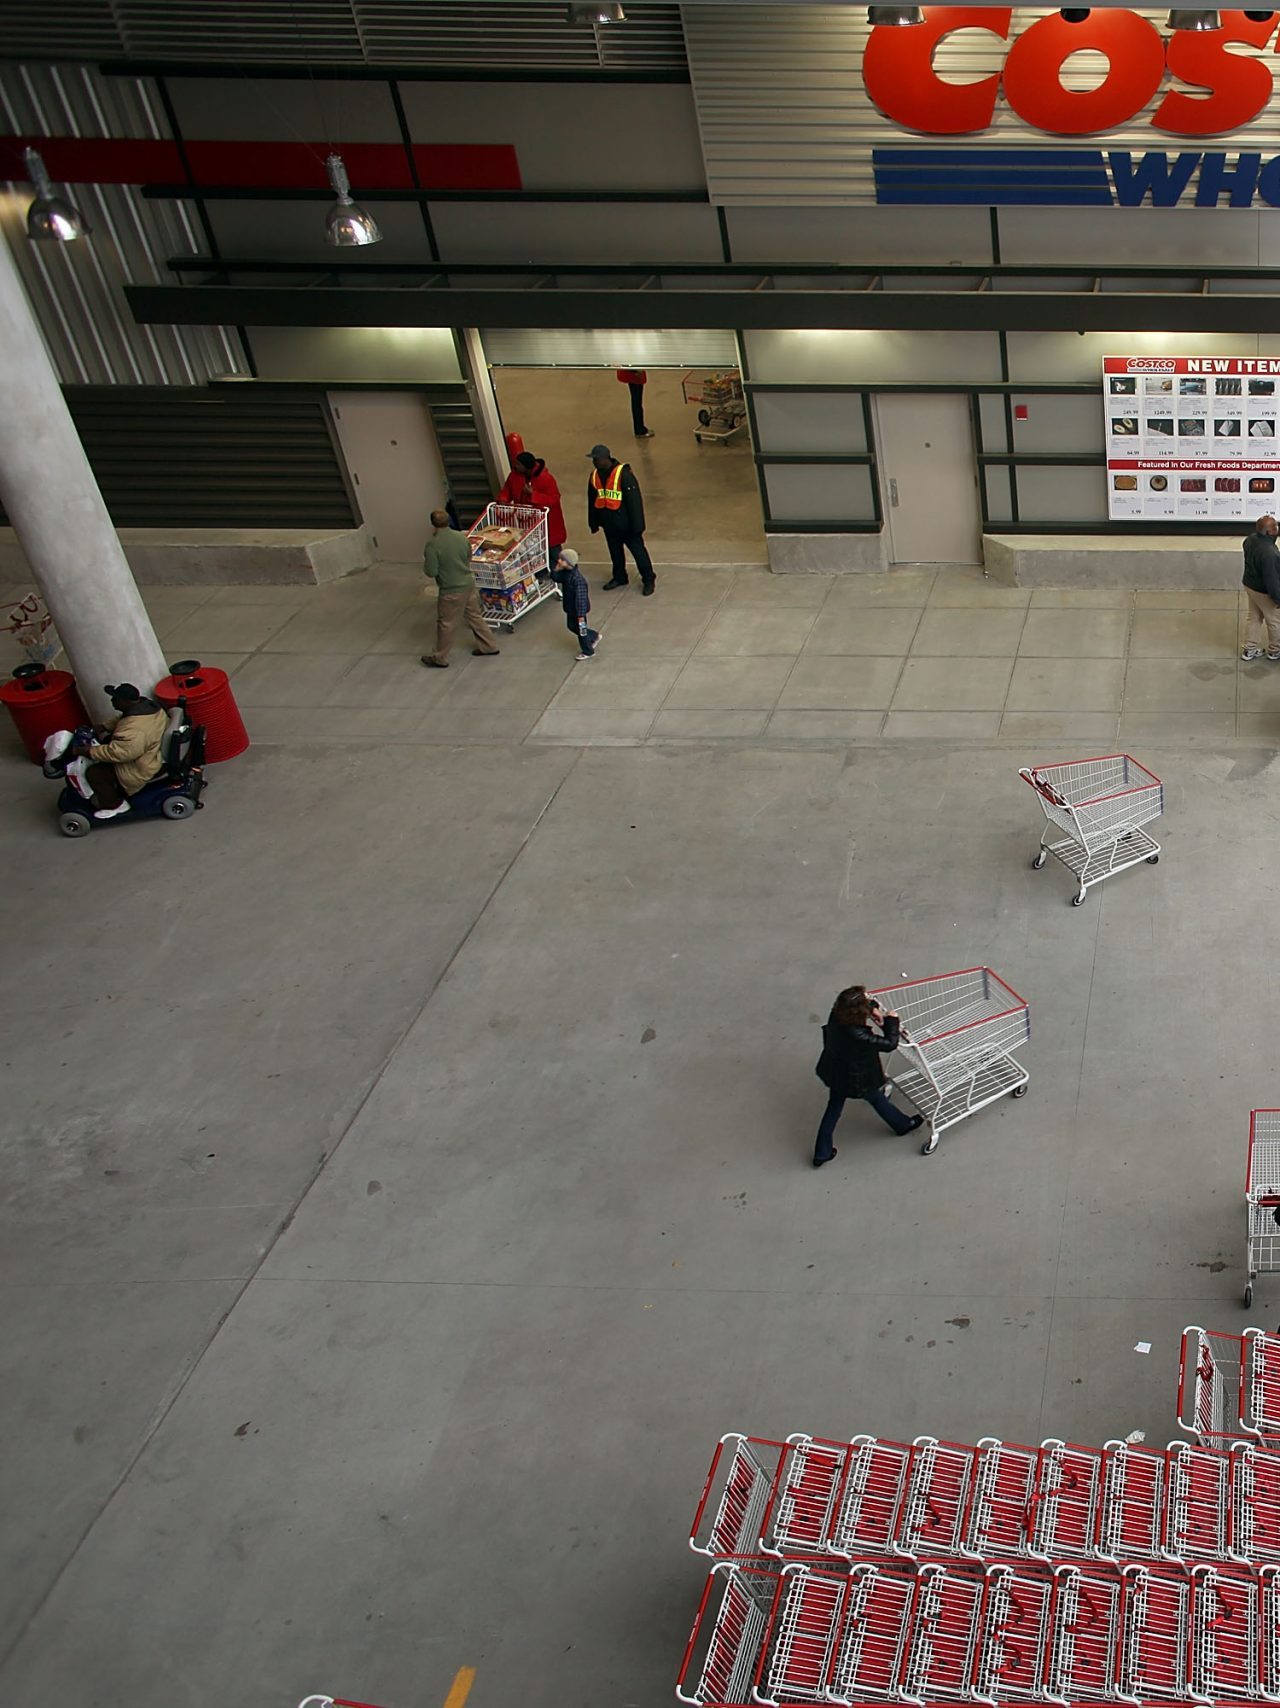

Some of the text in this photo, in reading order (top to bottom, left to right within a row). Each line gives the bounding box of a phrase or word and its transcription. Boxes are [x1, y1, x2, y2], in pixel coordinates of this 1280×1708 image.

[1127, 359, 1175, 368] COSTCO
[1187, 360, 1230, 372] NEW
[1137, 461, 1170, 469] Featured
[1171, 461, 1177, 469] In
[1179, 461, 1193, 469] Our
[1195, 461, 1216, 469] Fresh
[1217, 461, 1240, 469] Foods
